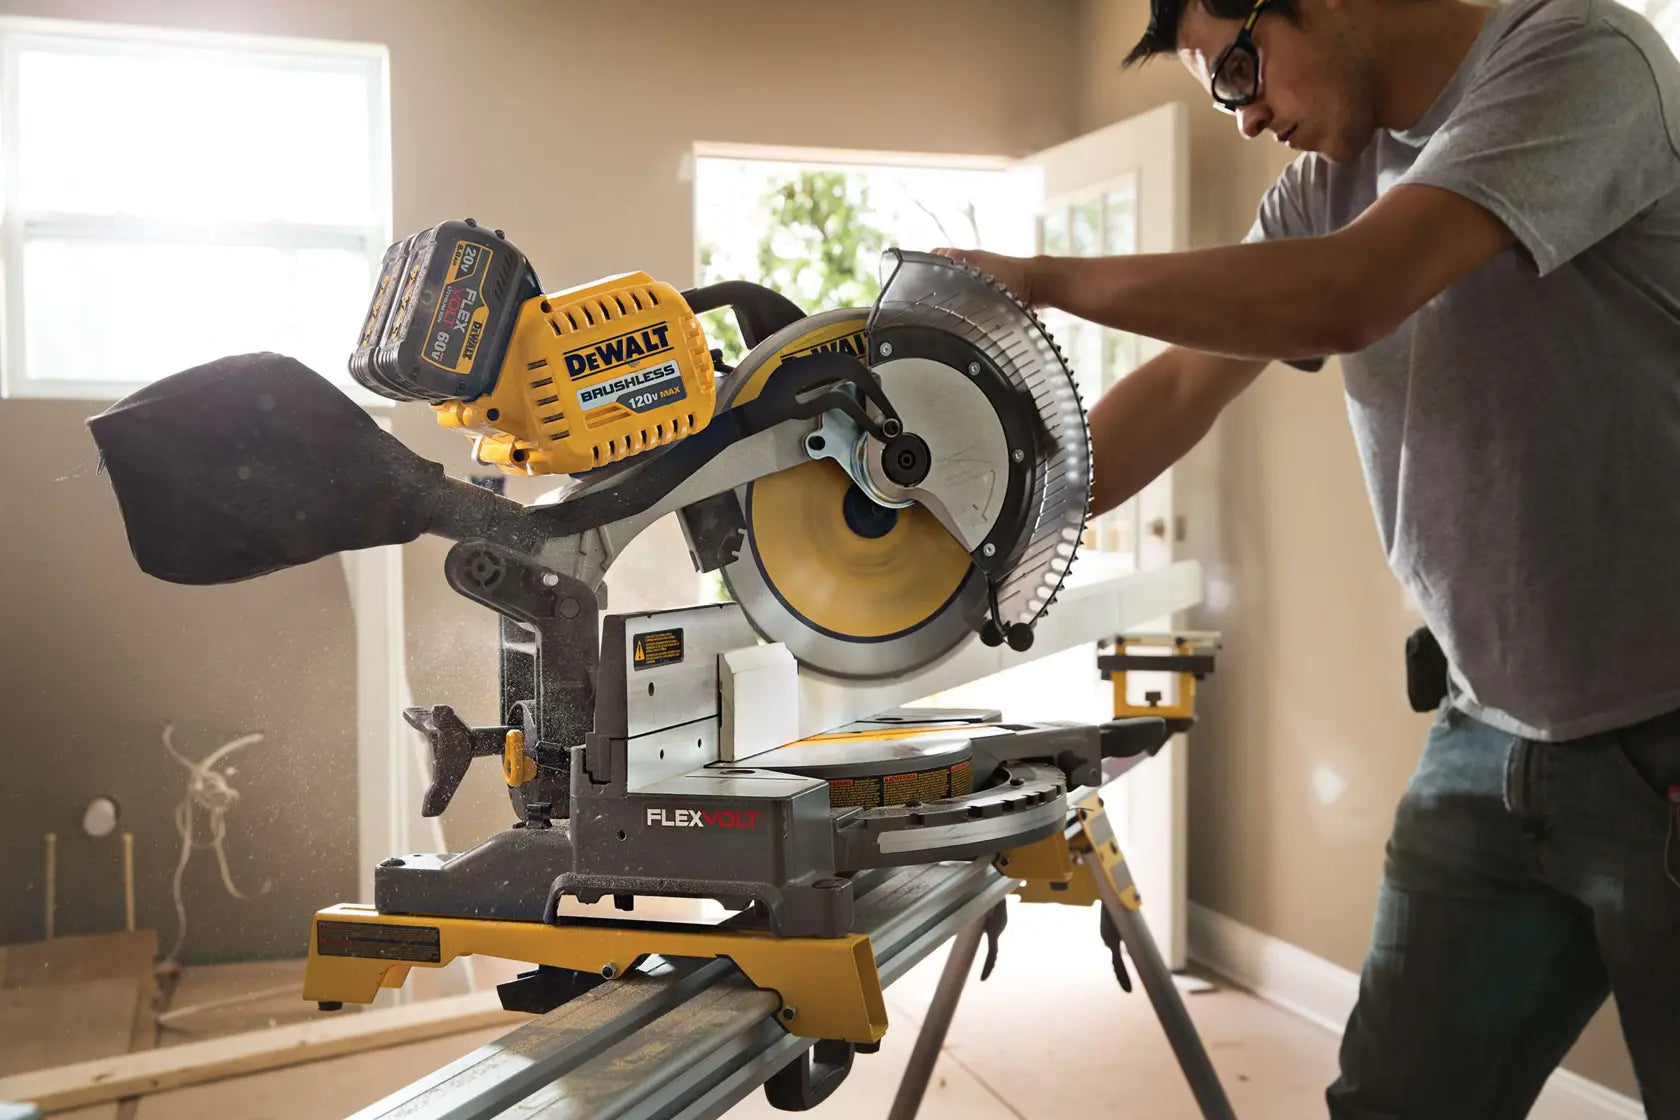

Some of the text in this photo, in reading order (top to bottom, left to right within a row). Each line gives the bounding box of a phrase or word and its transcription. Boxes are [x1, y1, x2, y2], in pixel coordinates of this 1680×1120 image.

[443, 287, 465, 328] VOLT
[453, 288, 477, 333] FLEX
[580, 364, 675, 403] BRUSHLESS
[660, 385, 680, 398] MAX
